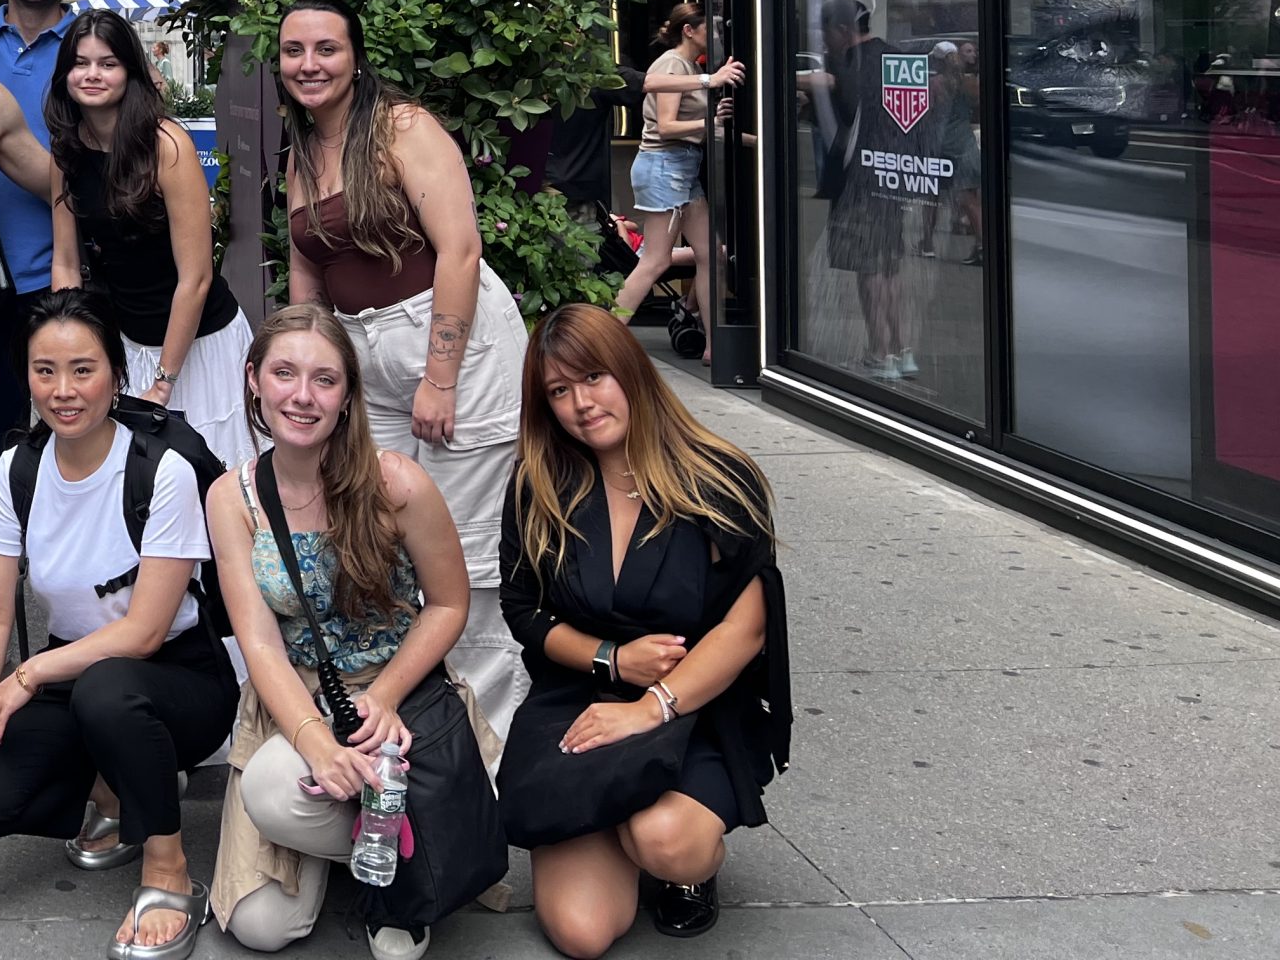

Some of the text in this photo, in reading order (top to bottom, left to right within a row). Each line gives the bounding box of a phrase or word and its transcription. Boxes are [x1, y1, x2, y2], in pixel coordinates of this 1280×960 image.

[885, 59, 925, 84] TAG
[885, 89, 926, 127] HEUER
[861, 149, 954, 178] DESIGNED
[874, 169, 939, 196] TO WIN
